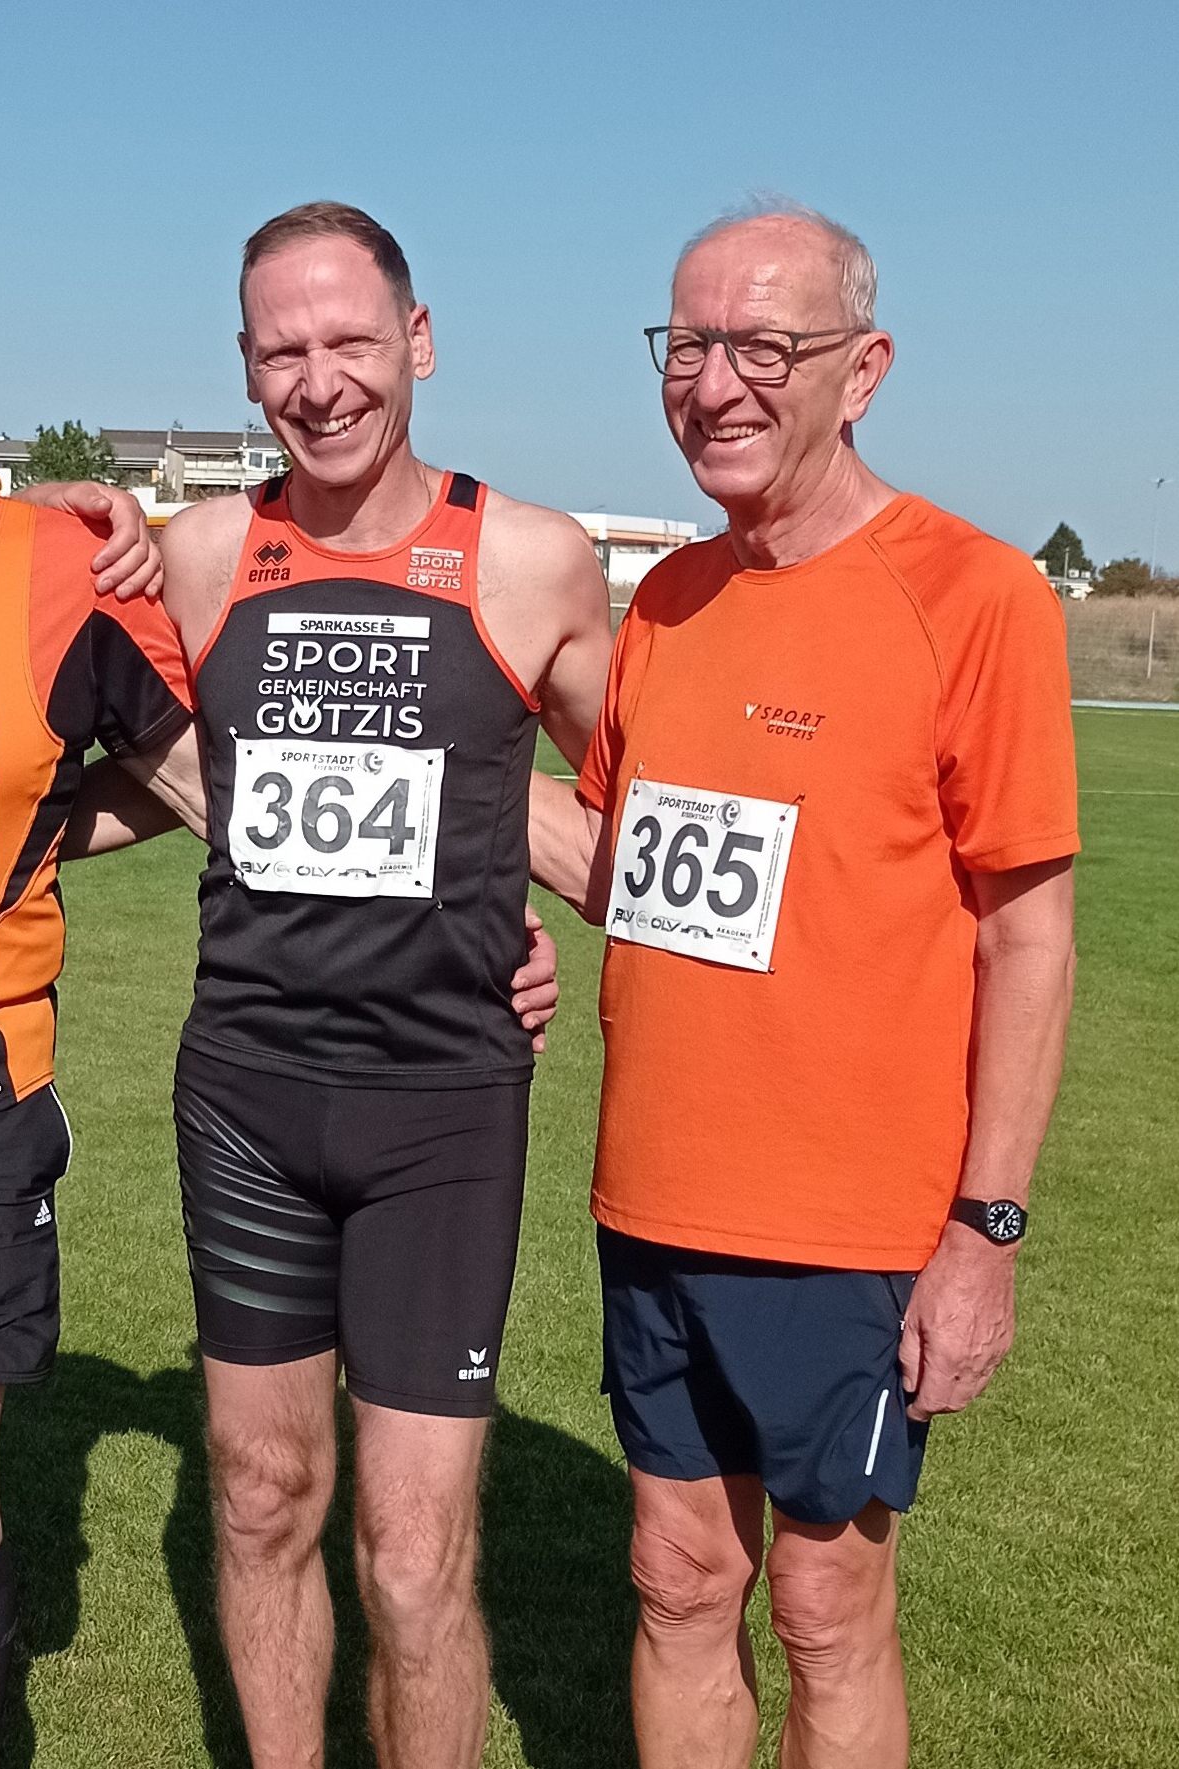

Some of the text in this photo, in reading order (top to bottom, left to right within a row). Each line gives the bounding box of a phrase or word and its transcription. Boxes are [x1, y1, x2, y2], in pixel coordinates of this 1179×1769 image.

[409, 555, 464, 570] SPORT
[300, 619, 379, 633] SPARKASSE
[262, 640, 430, 676] SPORT
[258, 678, 427, 700] GEMEINSCHAFT
[760, 706, 826, 728] SPORT
[281, 751, 356, 765] SPORTSTADT
[245, 771, 416, 855] 364
[657, 795, 717, 815] SPORTSTADT
[624, 815, 765, 919] 365
